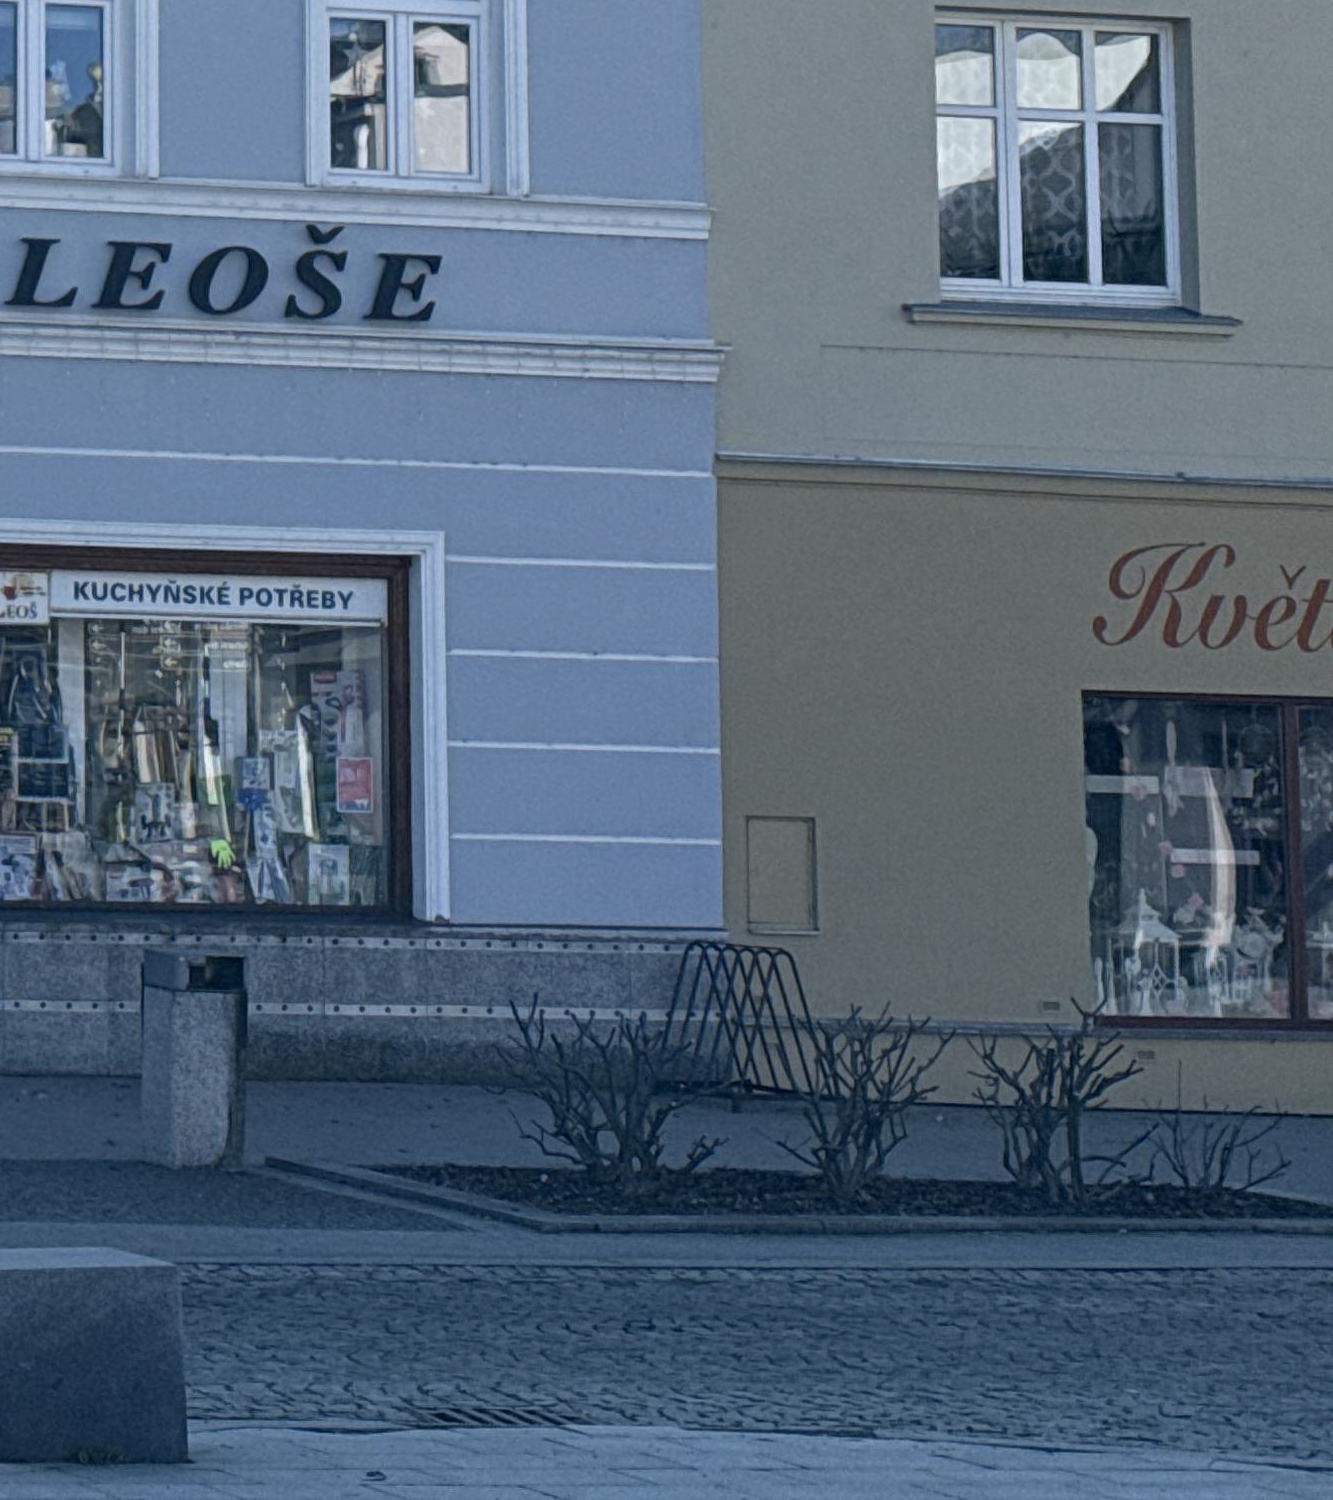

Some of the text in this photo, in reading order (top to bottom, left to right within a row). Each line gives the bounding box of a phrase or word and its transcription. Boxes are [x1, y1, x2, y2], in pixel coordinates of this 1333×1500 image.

[3, 224, 444, 323] LEOŠE
[73, 580, 355, 611] KUCHYŇSKÉ POTŘEBY
[1092, 541, 1333, 654] Květ
